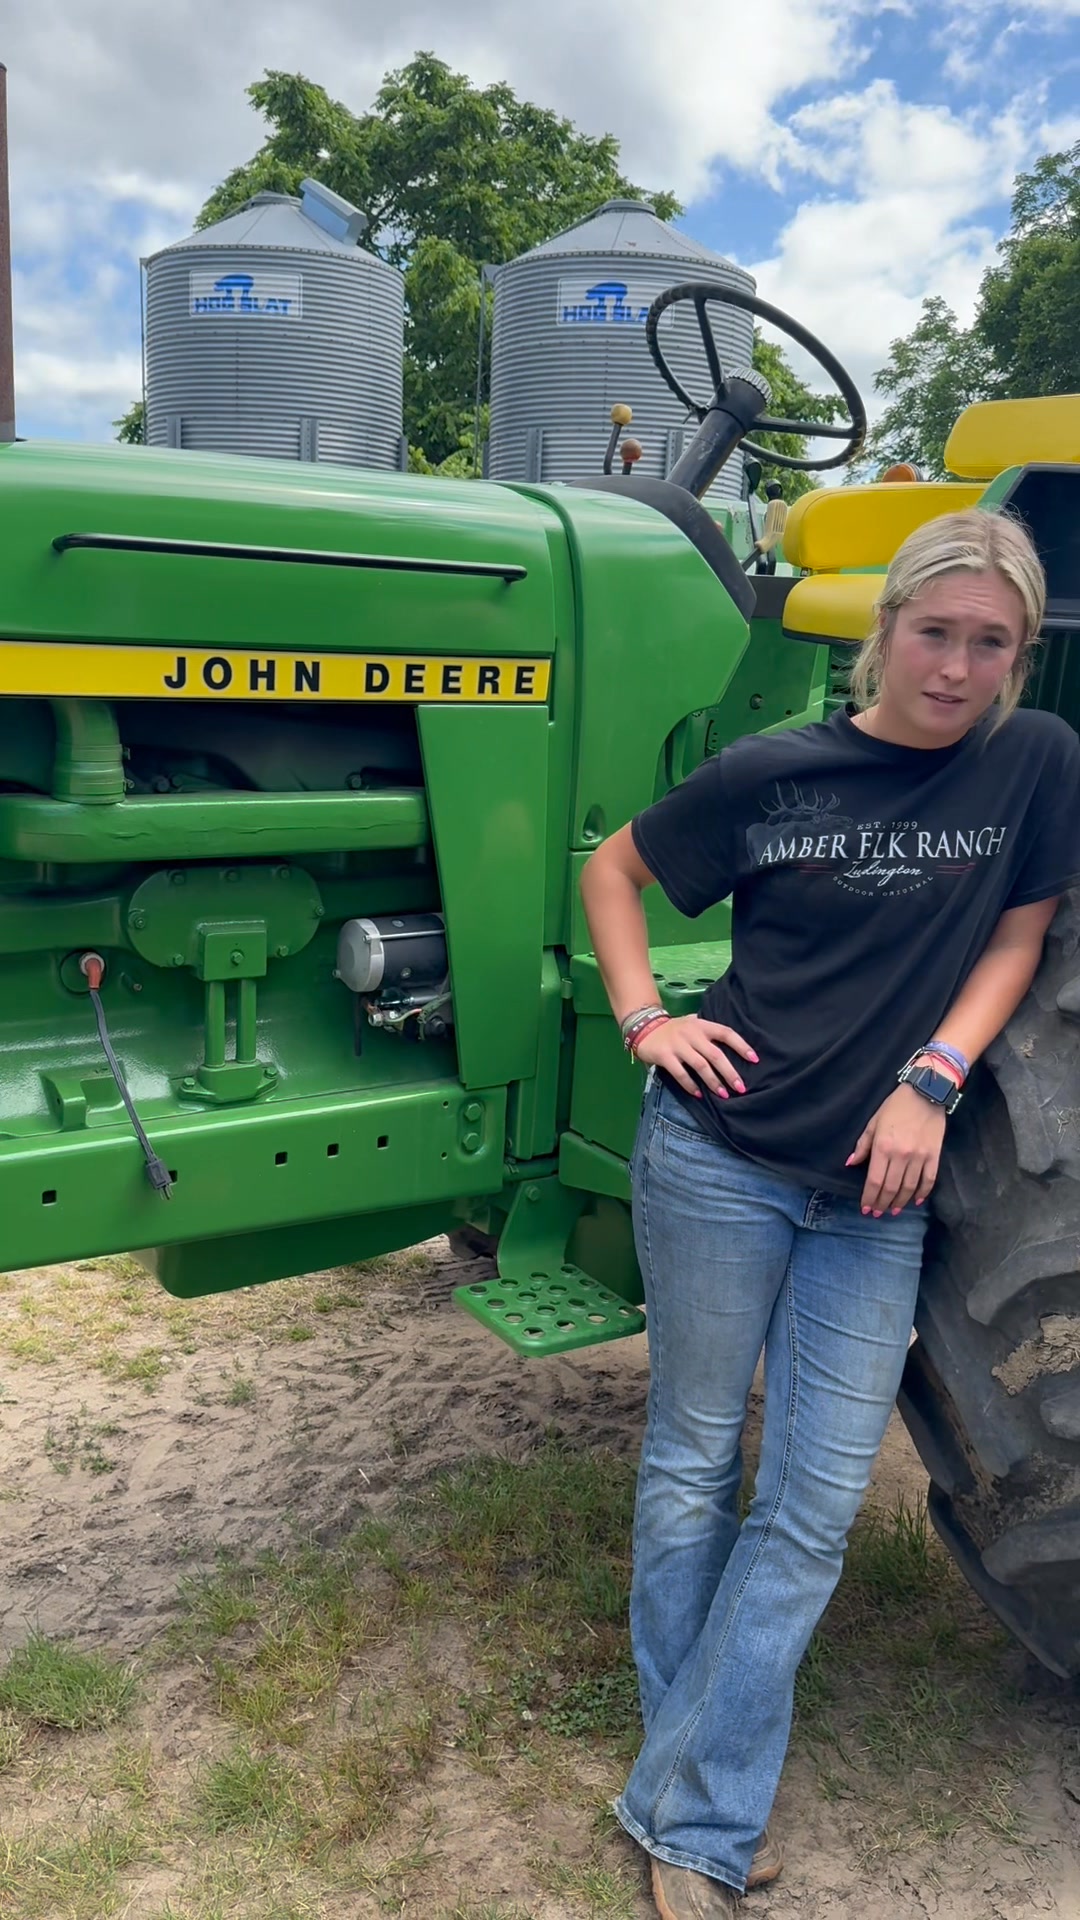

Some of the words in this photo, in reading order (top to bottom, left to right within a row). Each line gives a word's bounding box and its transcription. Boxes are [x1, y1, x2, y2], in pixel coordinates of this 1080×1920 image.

[613, 305, 650, 322] SLA
[164, 656, 321, 693] JOHN
[364, 662, 536, 695] DEERE
[759, 834, 849, 865] AMBER
[858, 832, 908, 859] ELK
[916, 826, 1007, 859] RANCH
